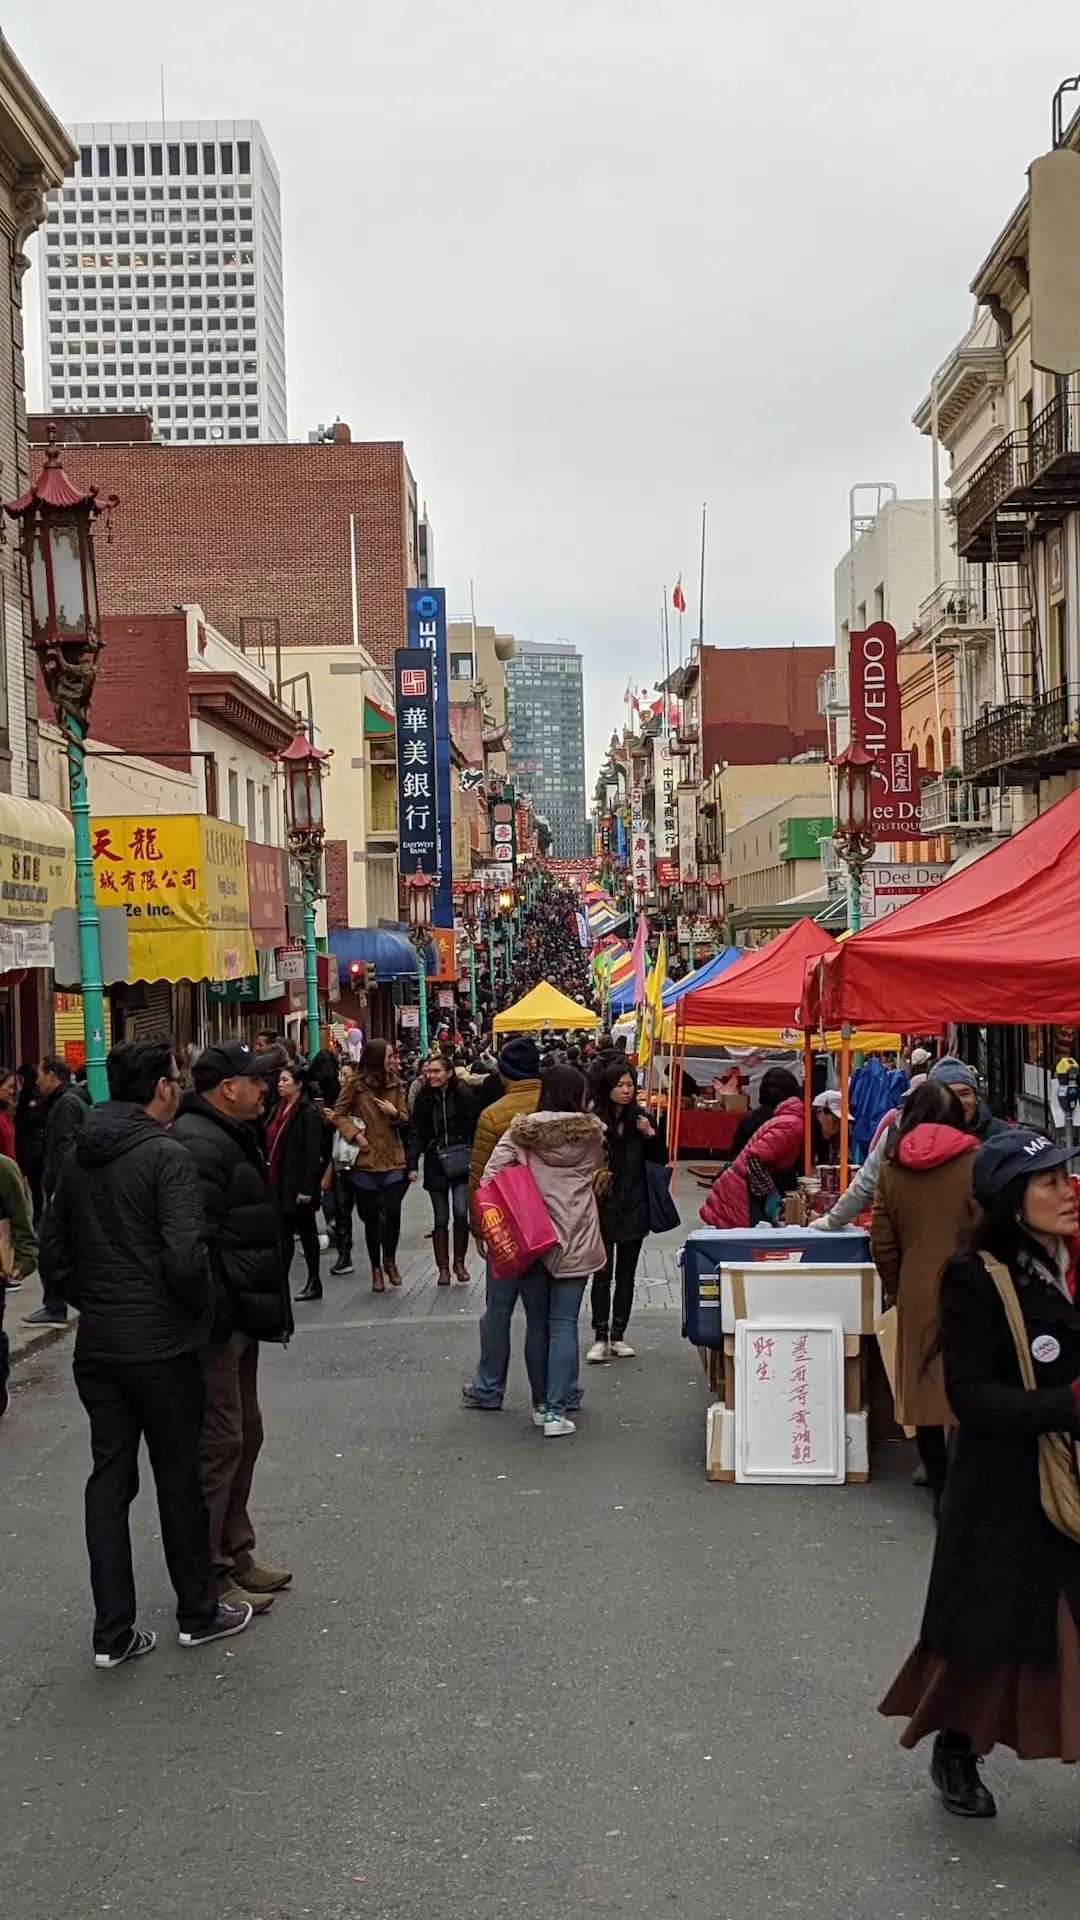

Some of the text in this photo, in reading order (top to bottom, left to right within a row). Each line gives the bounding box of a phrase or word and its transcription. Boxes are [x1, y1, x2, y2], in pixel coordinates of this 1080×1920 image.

[863, 637, 888, 795] SHISEIDO
[403, 707, 432, 831] 華美銀行
[872, 806, 894, 819] ee
[878, 870, 911, 885] Dee
[147, 902, 175, 917] Inc.
